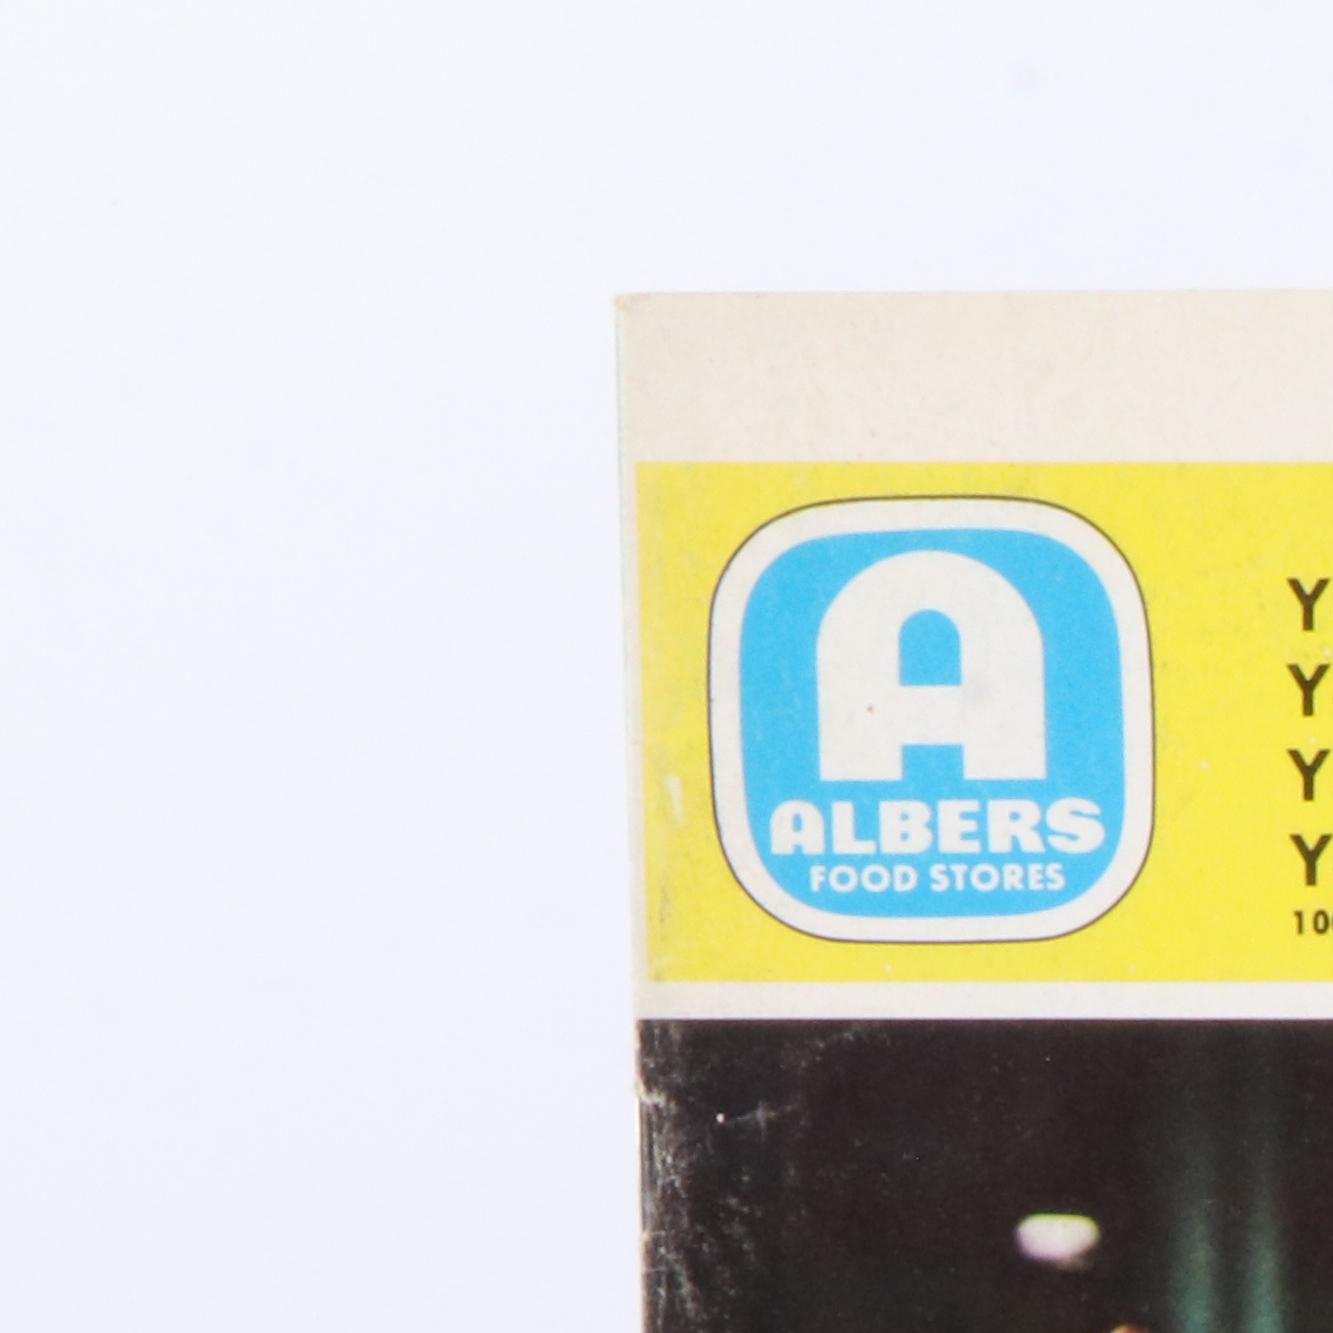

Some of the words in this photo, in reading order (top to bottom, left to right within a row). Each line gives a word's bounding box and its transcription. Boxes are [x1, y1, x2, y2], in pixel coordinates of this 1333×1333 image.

[769, 797, 1106, 856] ALBERS
[809, 864, 919, 894] FOOD
[929, 862, 1067, 892] STORES
